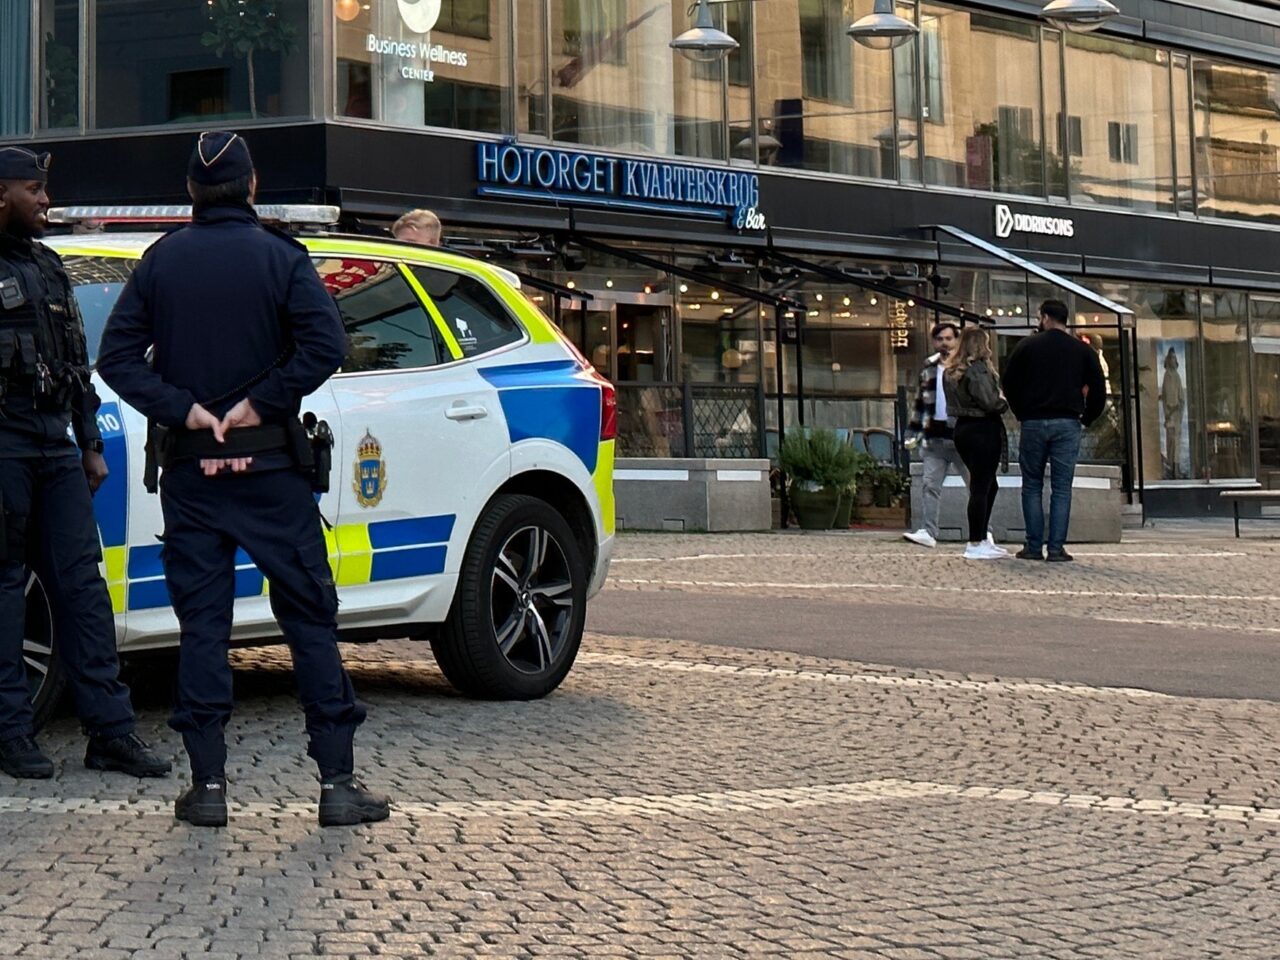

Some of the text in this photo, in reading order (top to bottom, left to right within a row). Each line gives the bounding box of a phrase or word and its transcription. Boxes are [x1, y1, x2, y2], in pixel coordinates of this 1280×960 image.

[366, 34, 468, 67] Business Wellness
[401, 66, 435, 82] CENTER
[625, 159, 760, 208] KVARTERSKROG
[745, 207, 767, 230] Bar
[1013, 213, 1074, 237] DIDRIKSONS
